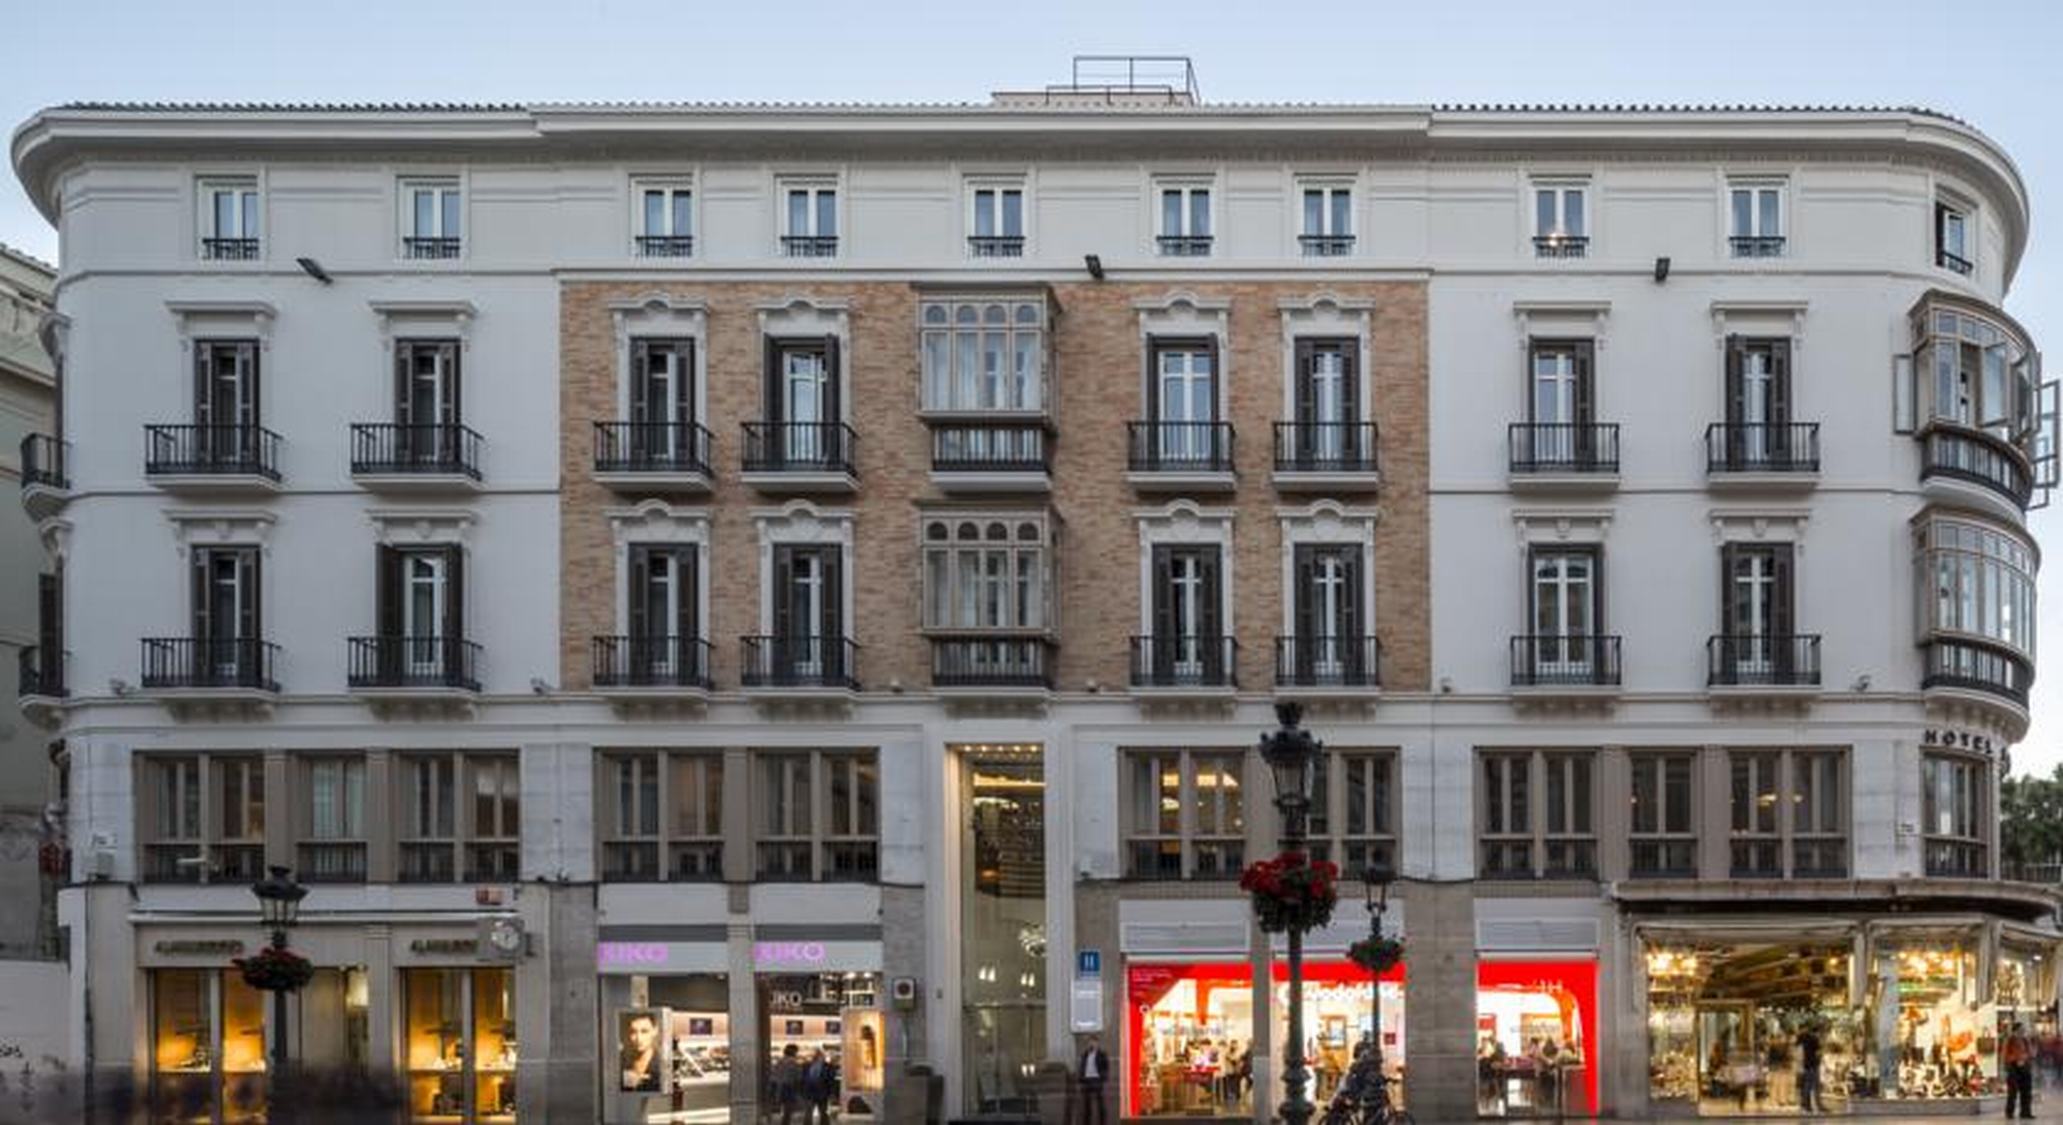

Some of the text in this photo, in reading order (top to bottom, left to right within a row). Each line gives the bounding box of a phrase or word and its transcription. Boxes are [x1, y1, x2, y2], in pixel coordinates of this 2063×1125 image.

[1924, 729, 1993, 754] HOTEL
[598, 942, 668, 963] KIKO
[756, 942, 826, 962] KIKO
